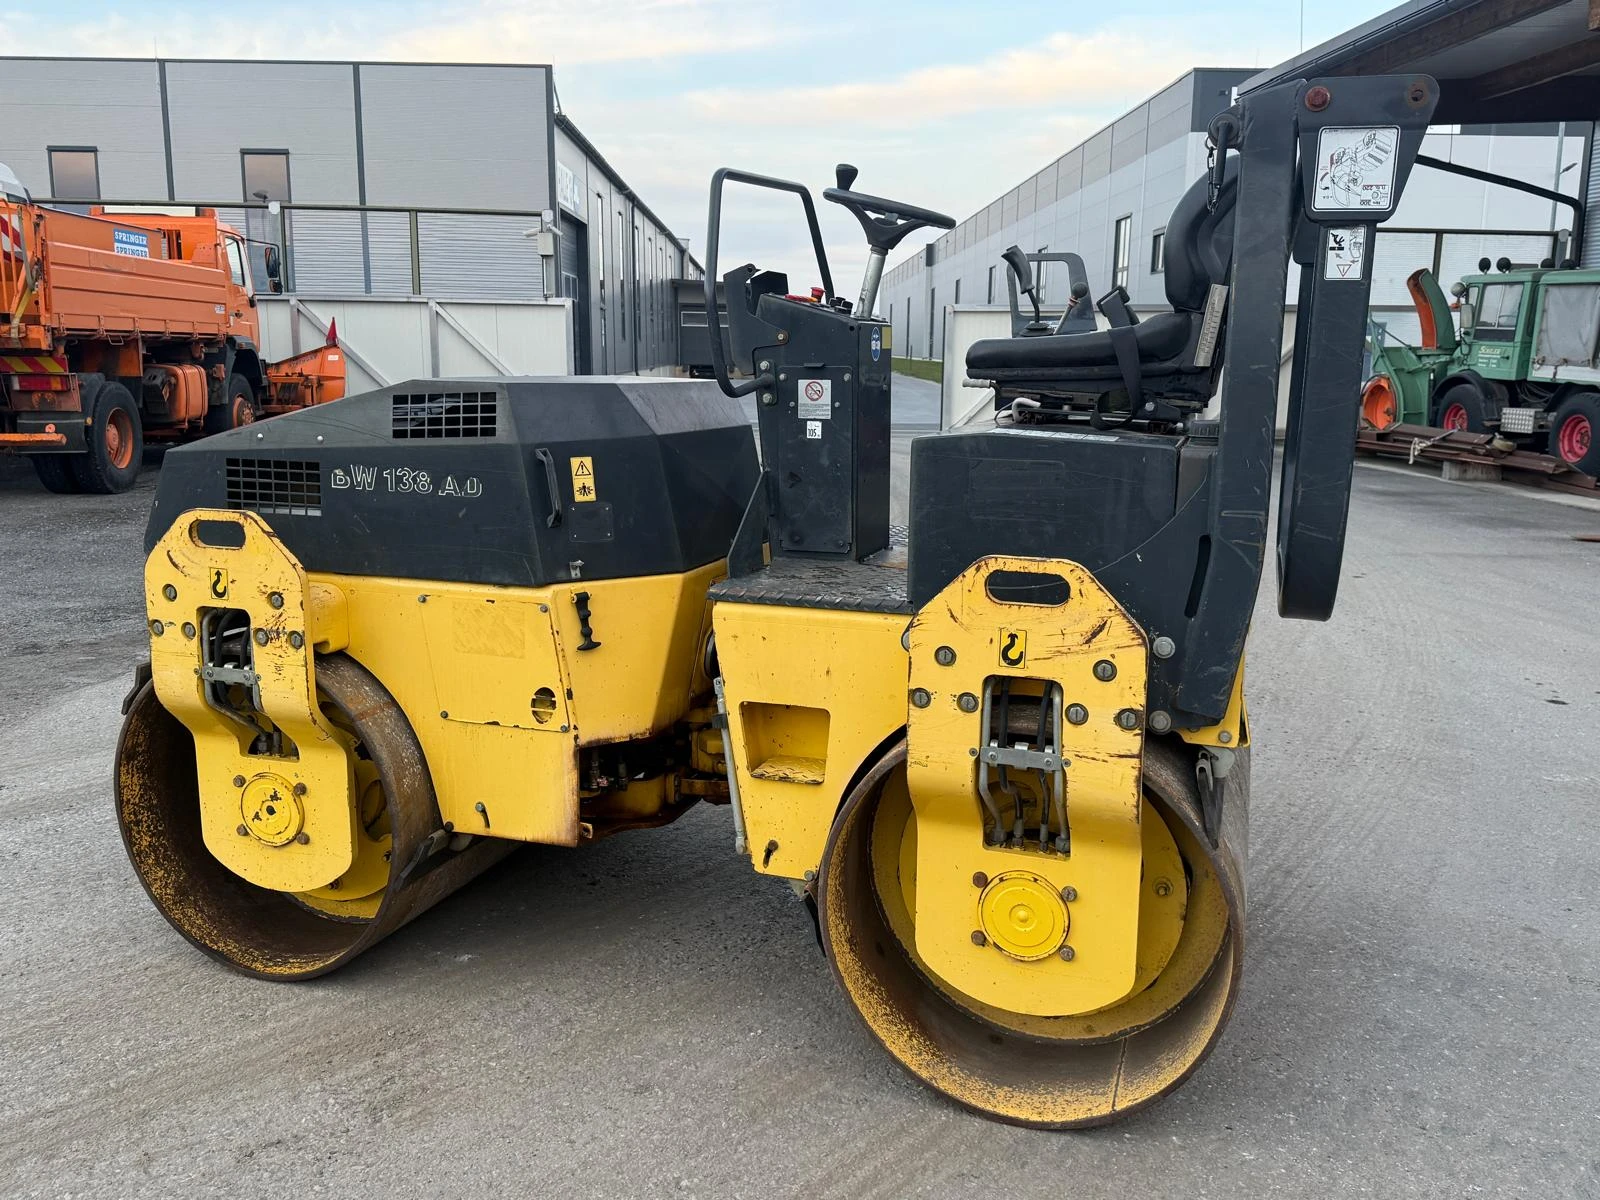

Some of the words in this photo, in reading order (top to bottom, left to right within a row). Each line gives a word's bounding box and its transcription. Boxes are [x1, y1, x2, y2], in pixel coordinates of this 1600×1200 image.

[114, 231, 147, 245] SPRINGER
[115, 246, 148, 258] SPRINGER
[807, 428, 817, 438] 105
[331, 464, 377, 491] BW
[383, 467, 433, 494] 138
